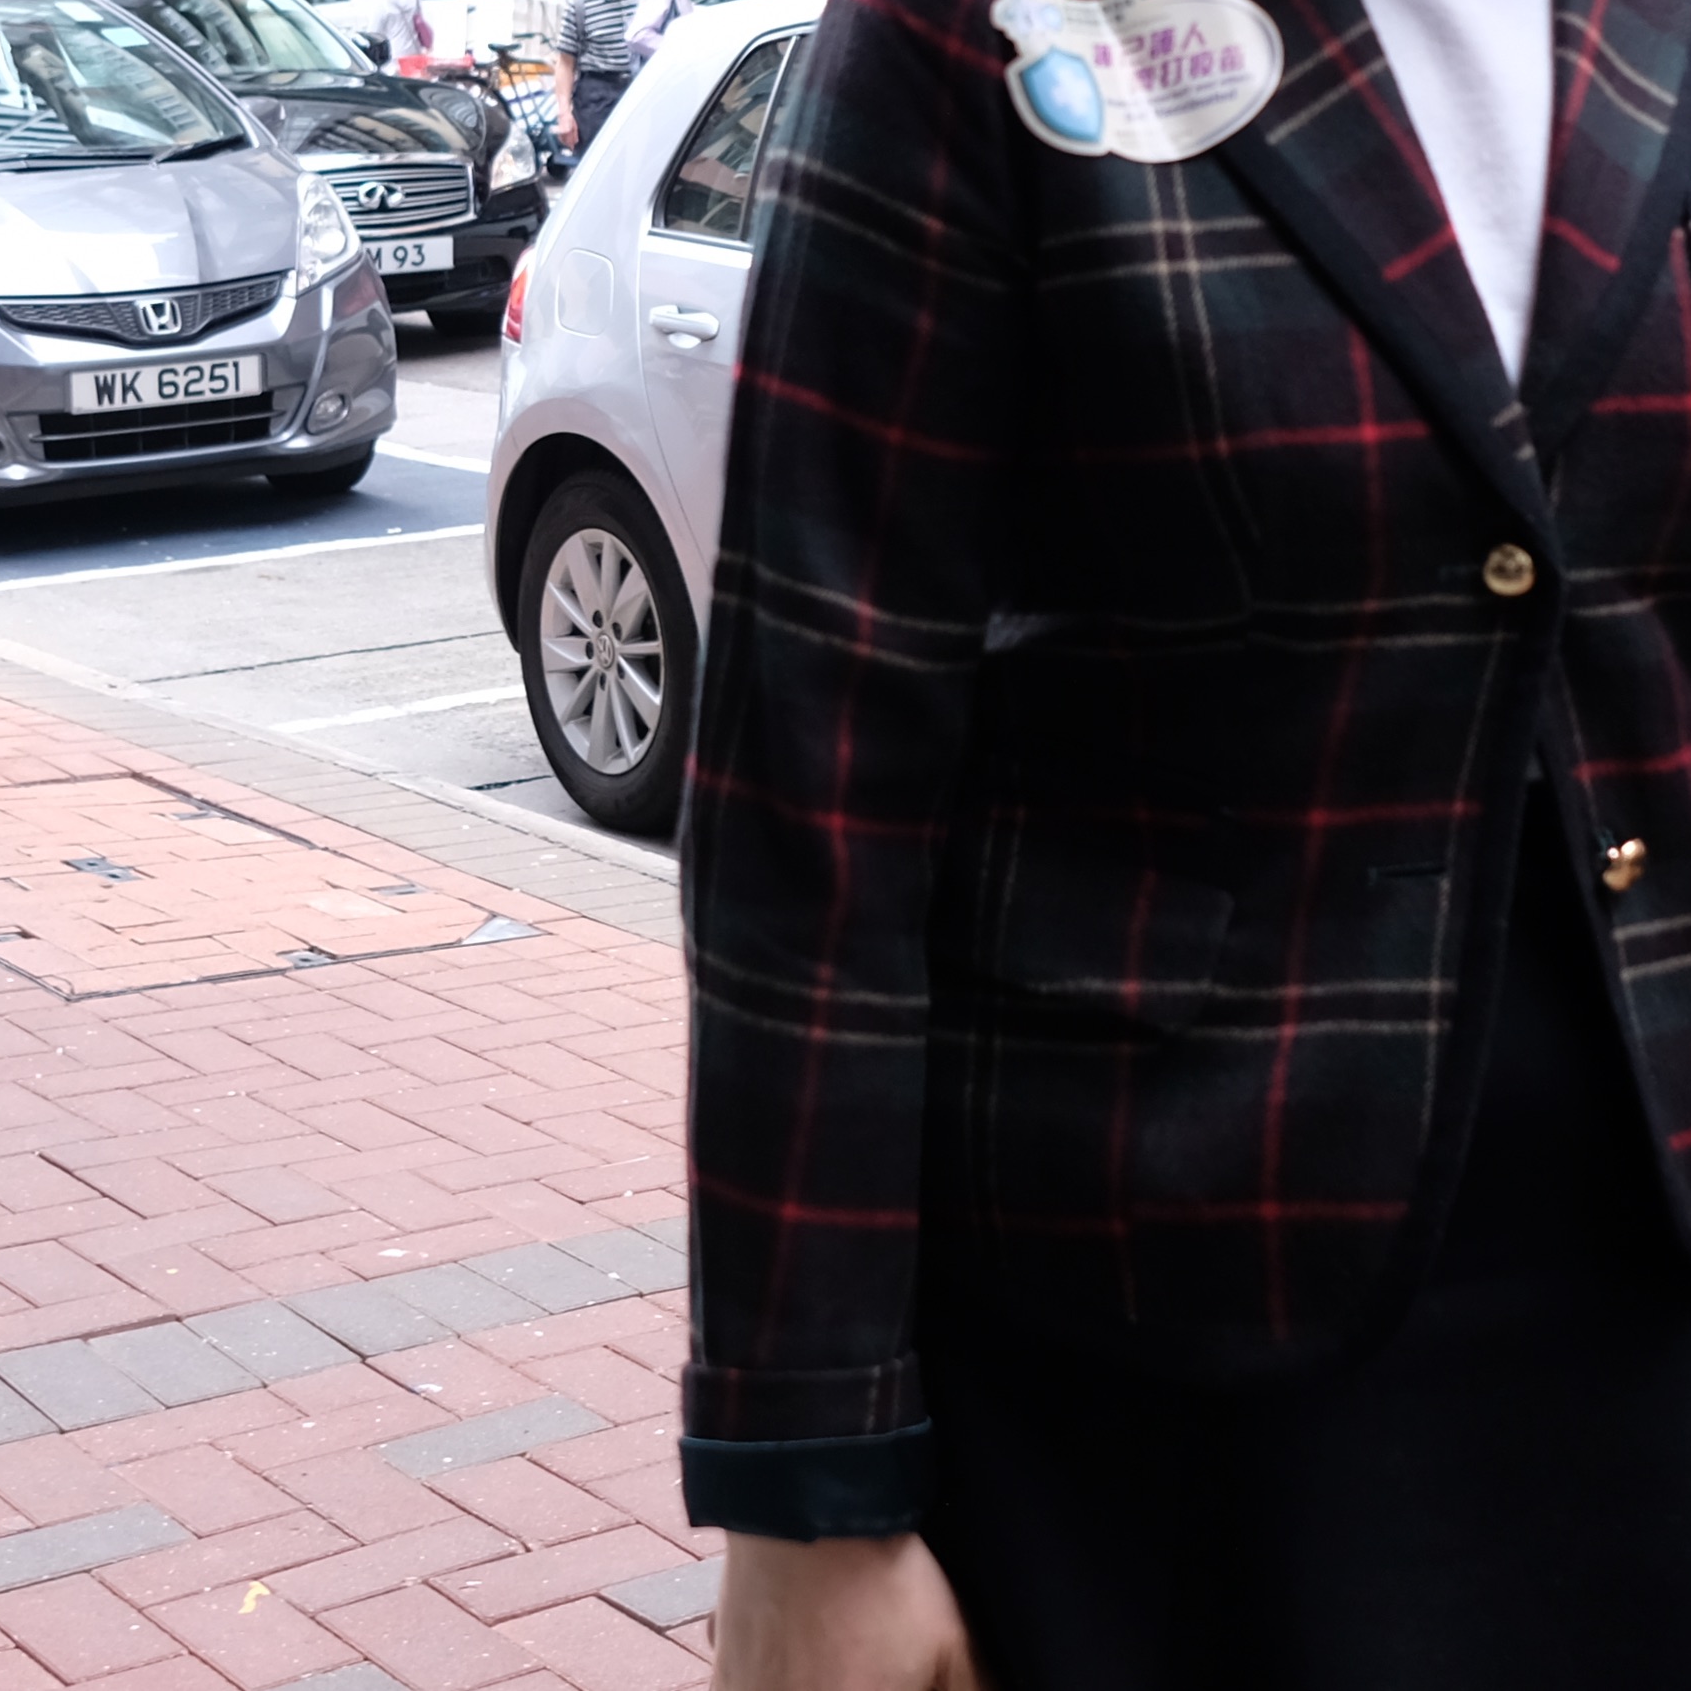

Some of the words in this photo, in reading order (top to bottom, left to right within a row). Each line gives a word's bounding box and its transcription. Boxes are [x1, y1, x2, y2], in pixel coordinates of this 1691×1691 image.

[392, 243, 426, 269] 93
[94, 370, 143, 407] WK
[159, 360, 241, 400] 6251
